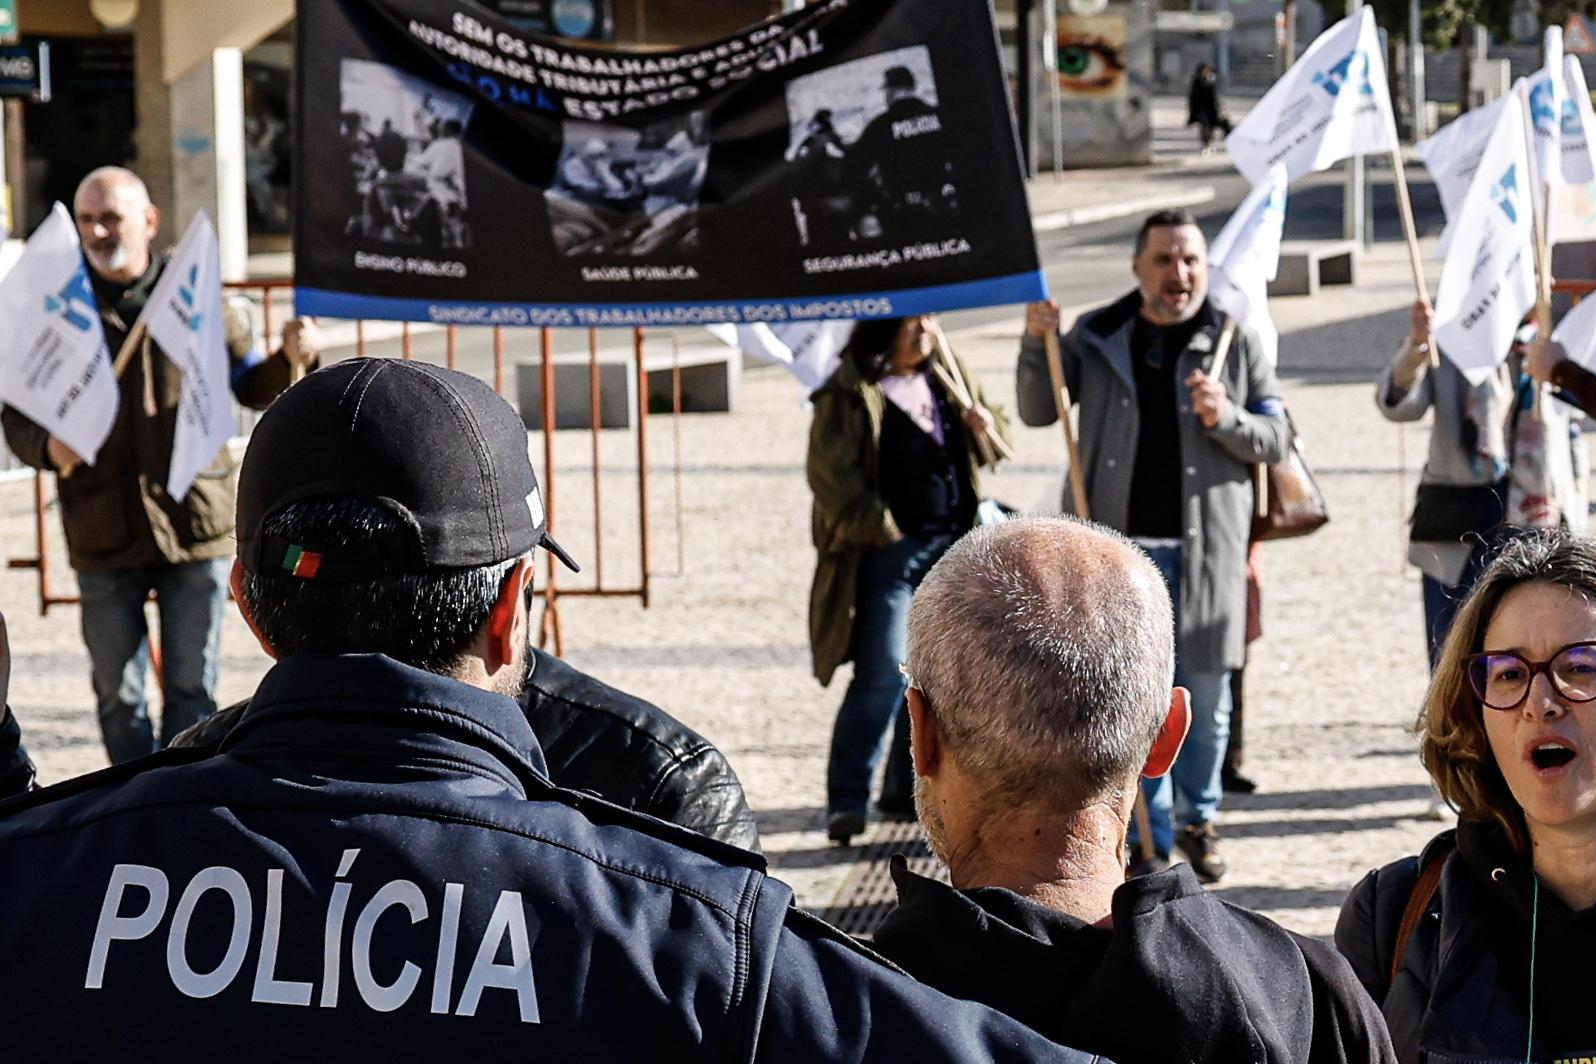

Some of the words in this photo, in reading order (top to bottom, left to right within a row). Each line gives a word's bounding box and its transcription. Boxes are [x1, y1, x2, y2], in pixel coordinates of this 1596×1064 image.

[452, 12, 494, 47] SEM
[496, 32, 528, 58] OS
[405, 256, 468, 278] PÚBLICO
[803, 253, 901, 274] SEGURANÇA
[902, 238, 971, 263] PÚBLICA
[633, 265, 699, 281] PÚBLICA
[428, 305, 527, 325] SINDICATO
[530, 308, 574, 325] DOS
[575, 307, 741, 325] TRABALHADORES
[744, 305, 786, 321] DOS
[790, 298, 893, 320] IMPOSTOS
[85, 848, 541, 1024] POLÍCIA
